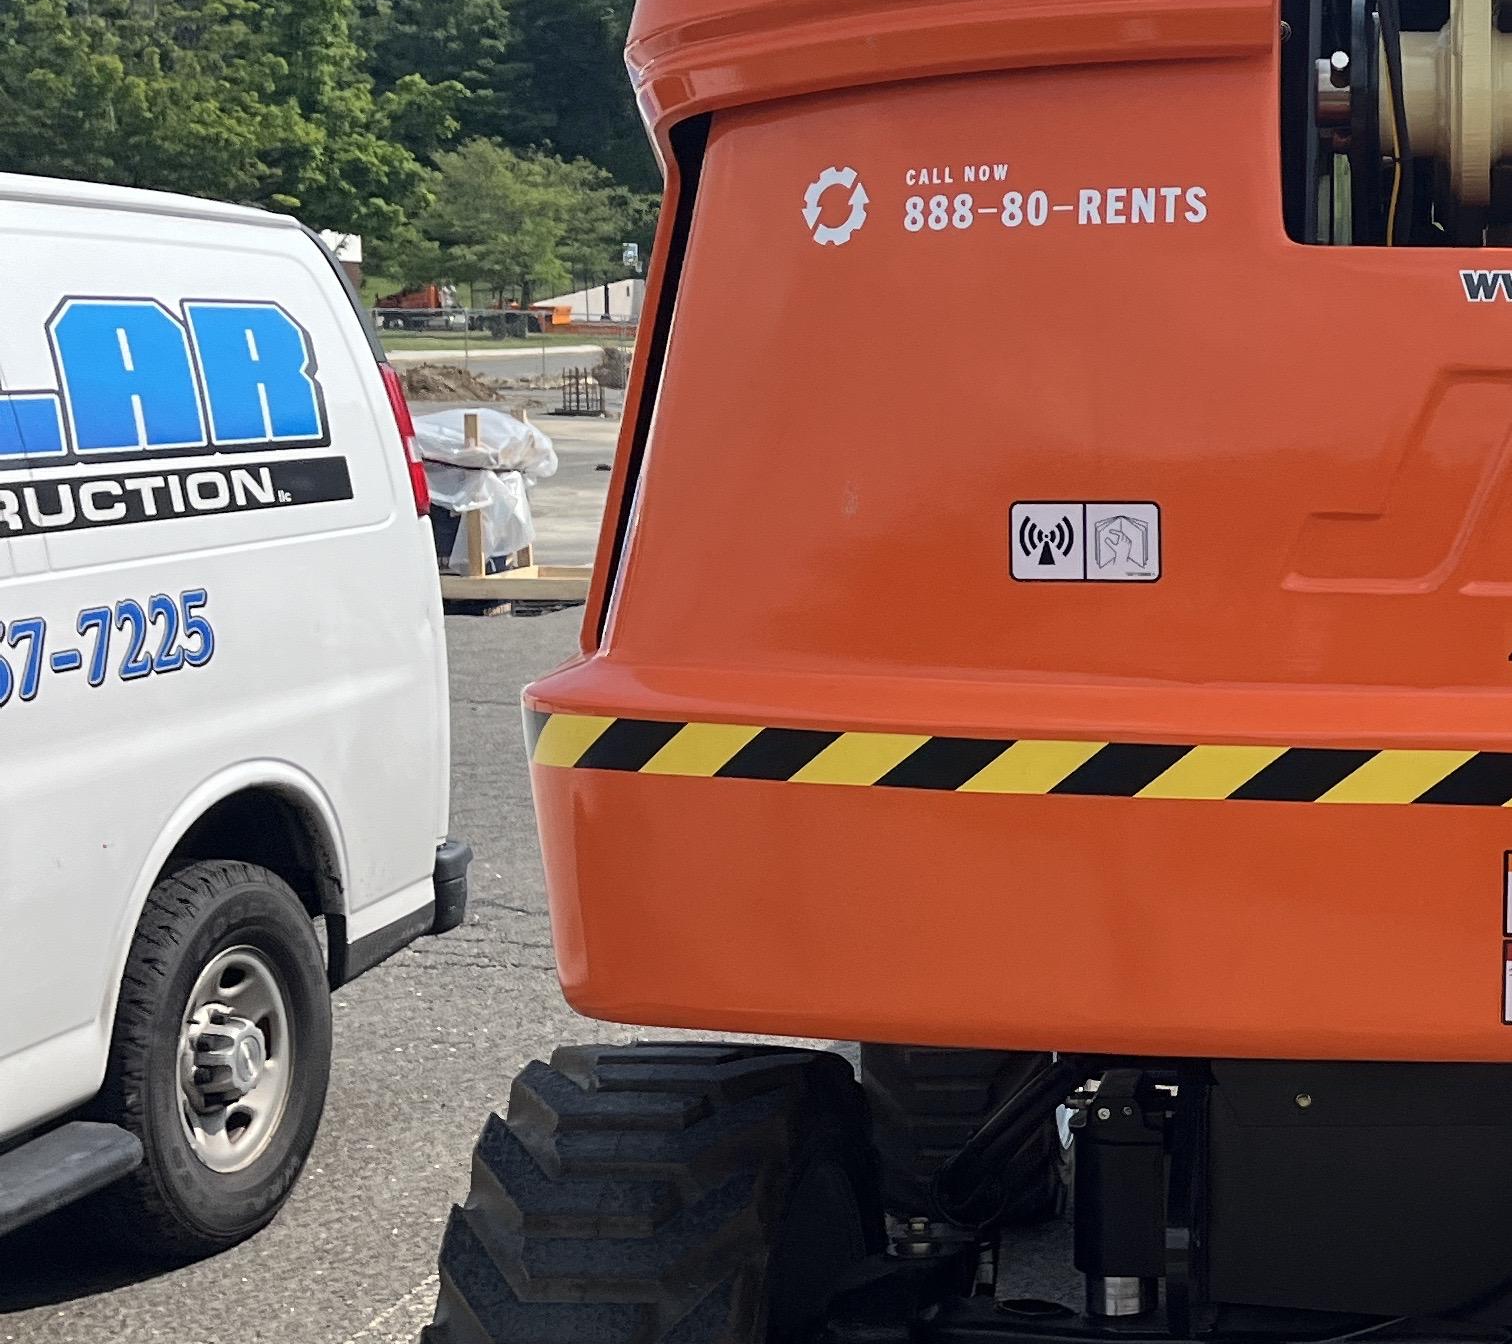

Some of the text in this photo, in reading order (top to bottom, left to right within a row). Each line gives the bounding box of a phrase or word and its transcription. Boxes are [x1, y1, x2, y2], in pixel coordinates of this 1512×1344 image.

[905, 163, 1009, 186] CALL NOW
[903, 186, 1208, 233] 888-80-RENTS
